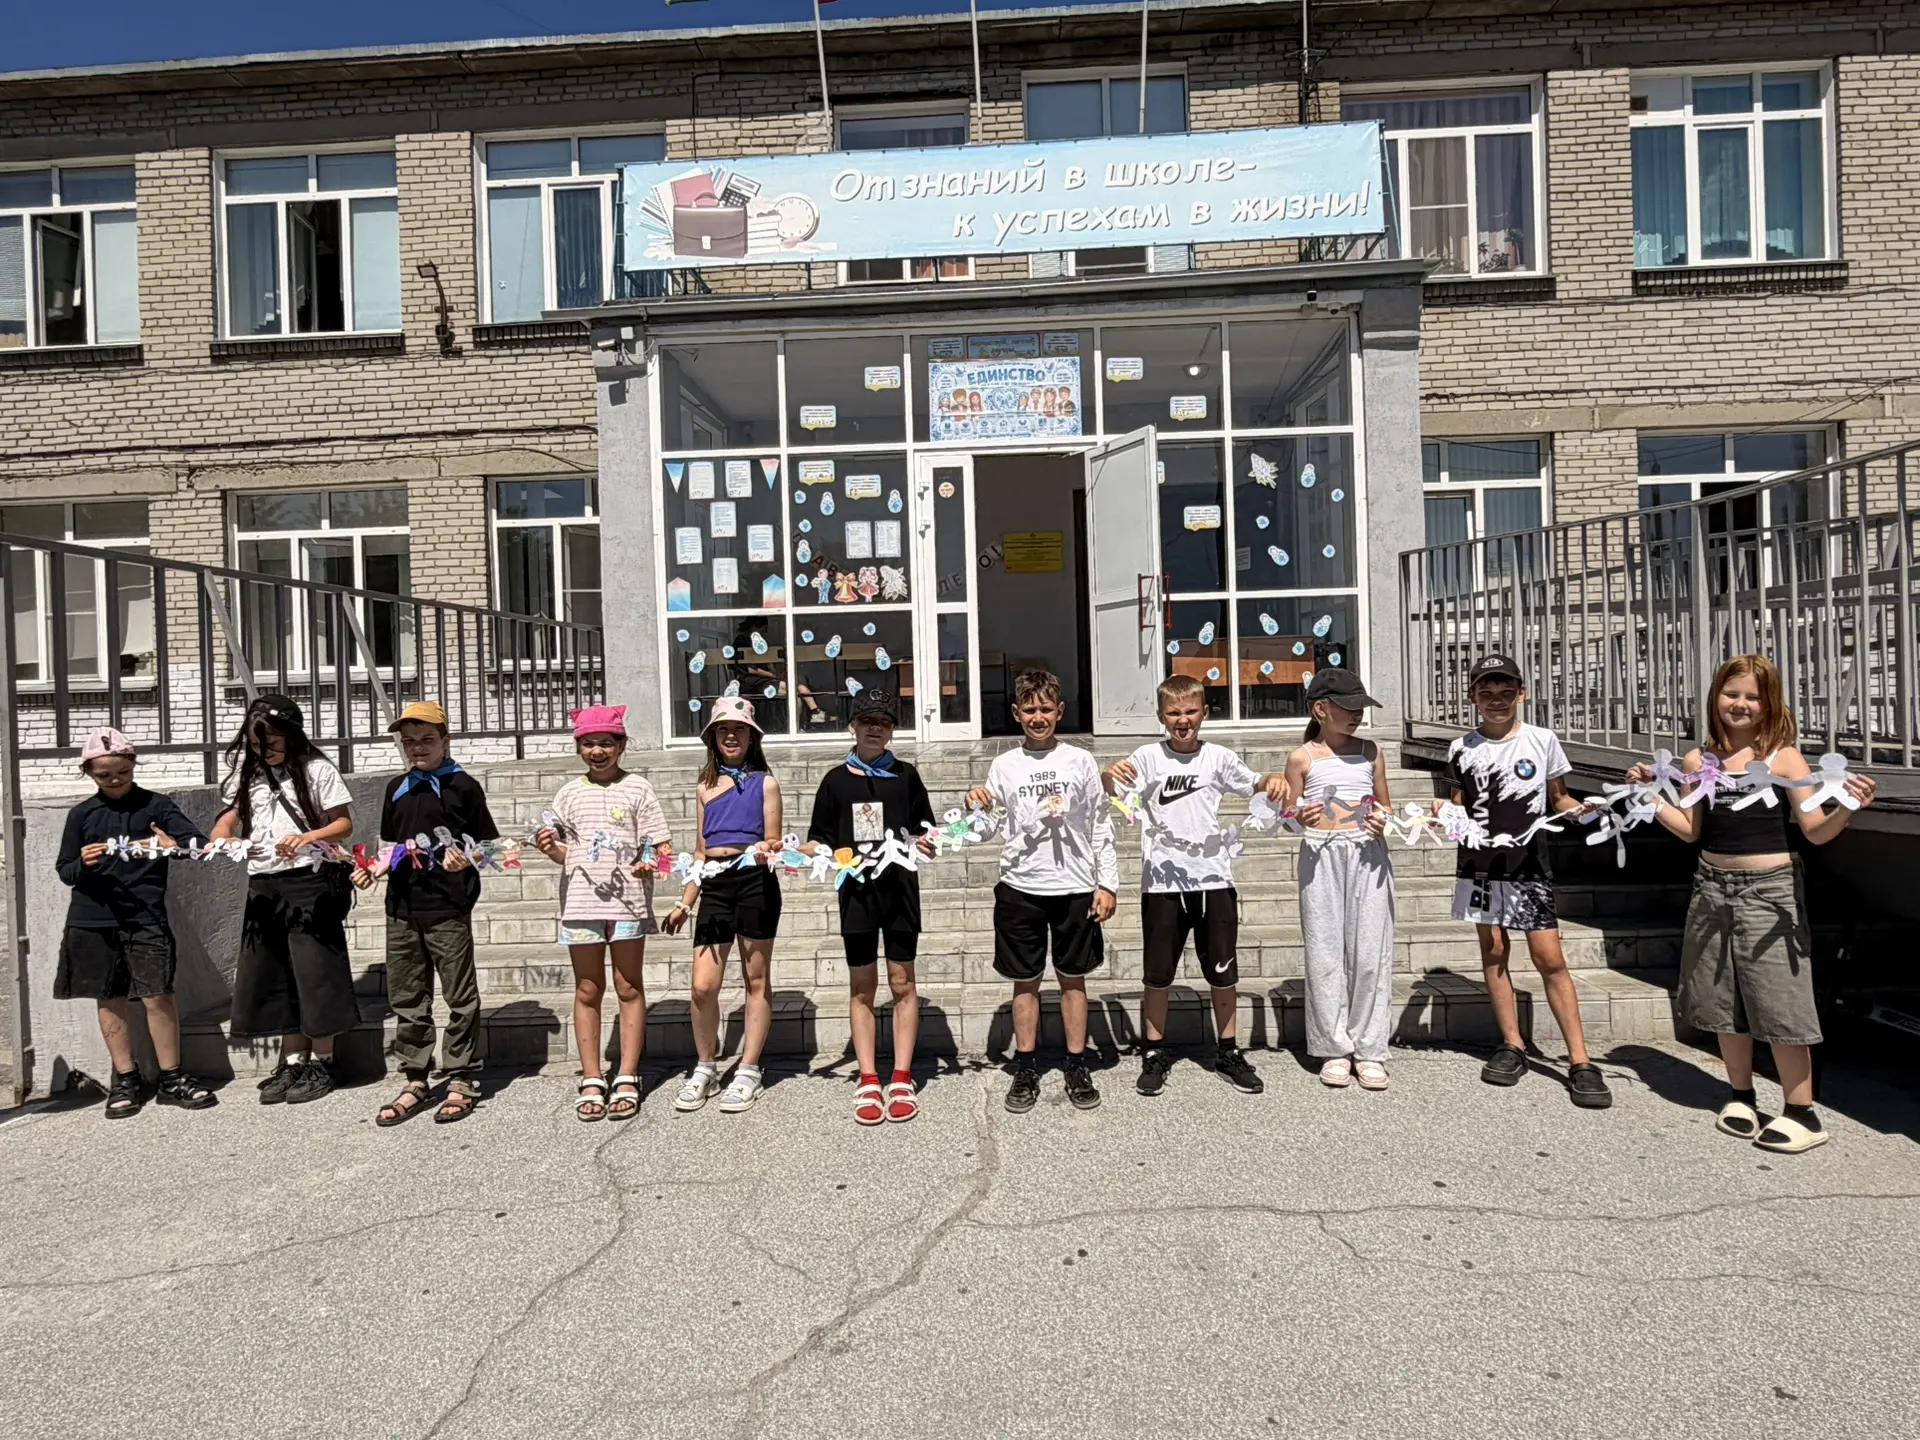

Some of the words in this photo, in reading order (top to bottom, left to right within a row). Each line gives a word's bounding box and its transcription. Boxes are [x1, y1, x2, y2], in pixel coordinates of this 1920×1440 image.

[830, 168, 896, 202] От
[902, 157, 1046, 199] знаний
[1064, 165, 1087, 190] в
[1104, 157, 1257, 188] школе-
[952, 213, 976, 237] к
[992, 202, 1171, 247] успехам
[1189, 200, 1212, 226] в
[1229, 179, 1371, 223] жизни!
[967, 368, 1046, 386] ЕДИНСТВО
[1029, 771, 1056, 783] 1989
[1164, 774, 1199, 792] NIKE
[1019, 782, 1070, 798] SYDNEY
